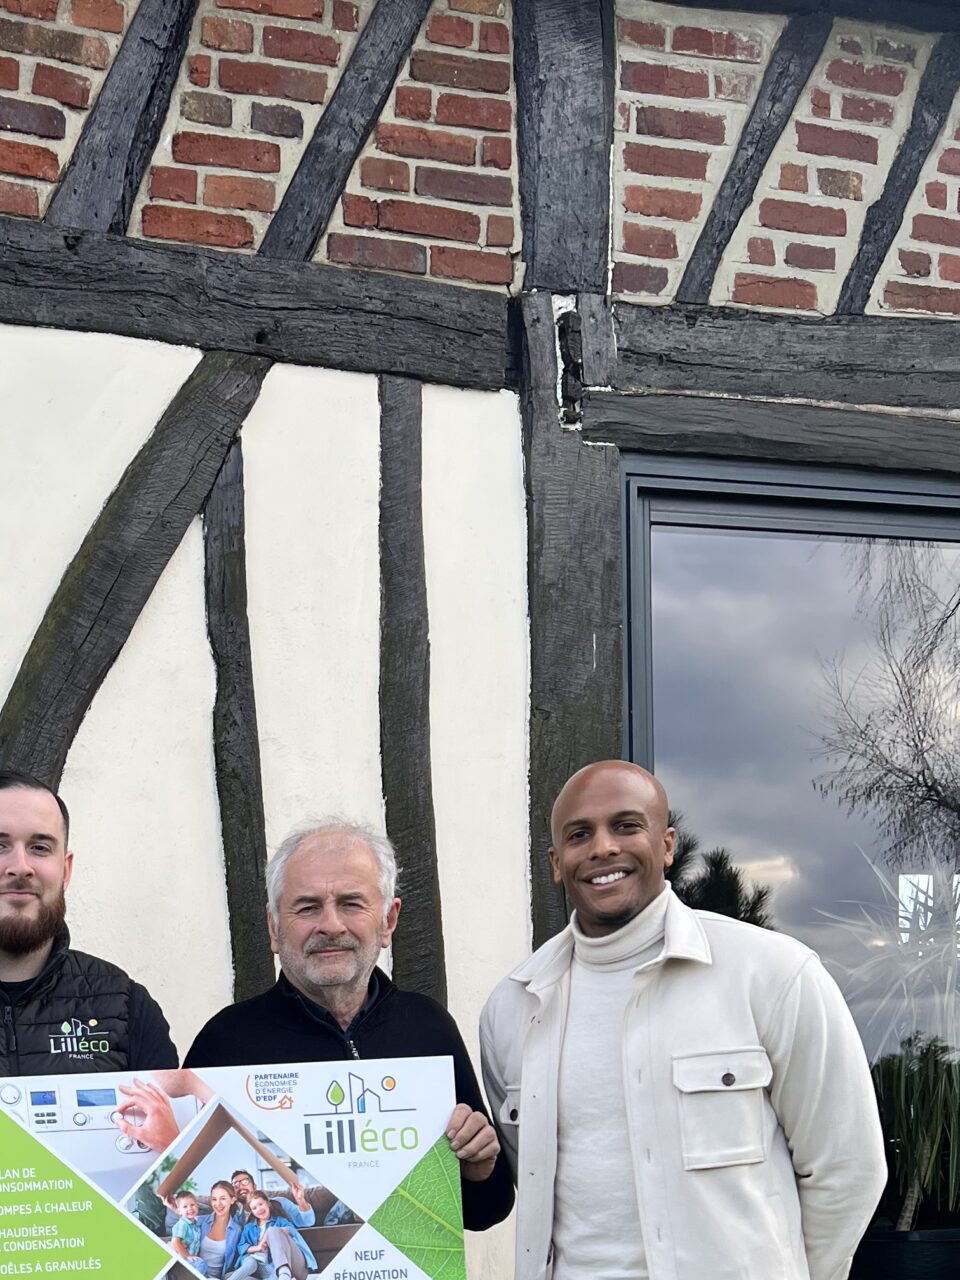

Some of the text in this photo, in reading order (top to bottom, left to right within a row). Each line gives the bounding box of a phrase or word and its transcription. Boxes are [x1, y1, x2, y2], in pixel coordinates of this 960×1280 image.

[50, 1037, 110, 1054] Lilléco
[254, 1072, 299, 1080] PARTENAIRE
[254, 1079, 297, 1088] ÉCONOMIES
[255, 1086, 293, 1095] D'ÉNERGIE
[255, 1094, 278, 1102] D'EDF
[304, 1119, 419, 1155] Lilléco
[348, 1160, 380, 1169] FRANCE
[22, 1167, 36, 1179] DE
[34, 1201, 42, 1213] À
[44, 1200, 93, 1213] CHALEUR
[3, 1237, 85, 1252] CONDENSATION
[354, 1249, 385, 1262] NEUF
[35, 1260, 43, 1273] À
[45, 1257, 102, 1273] GRANULÉS
